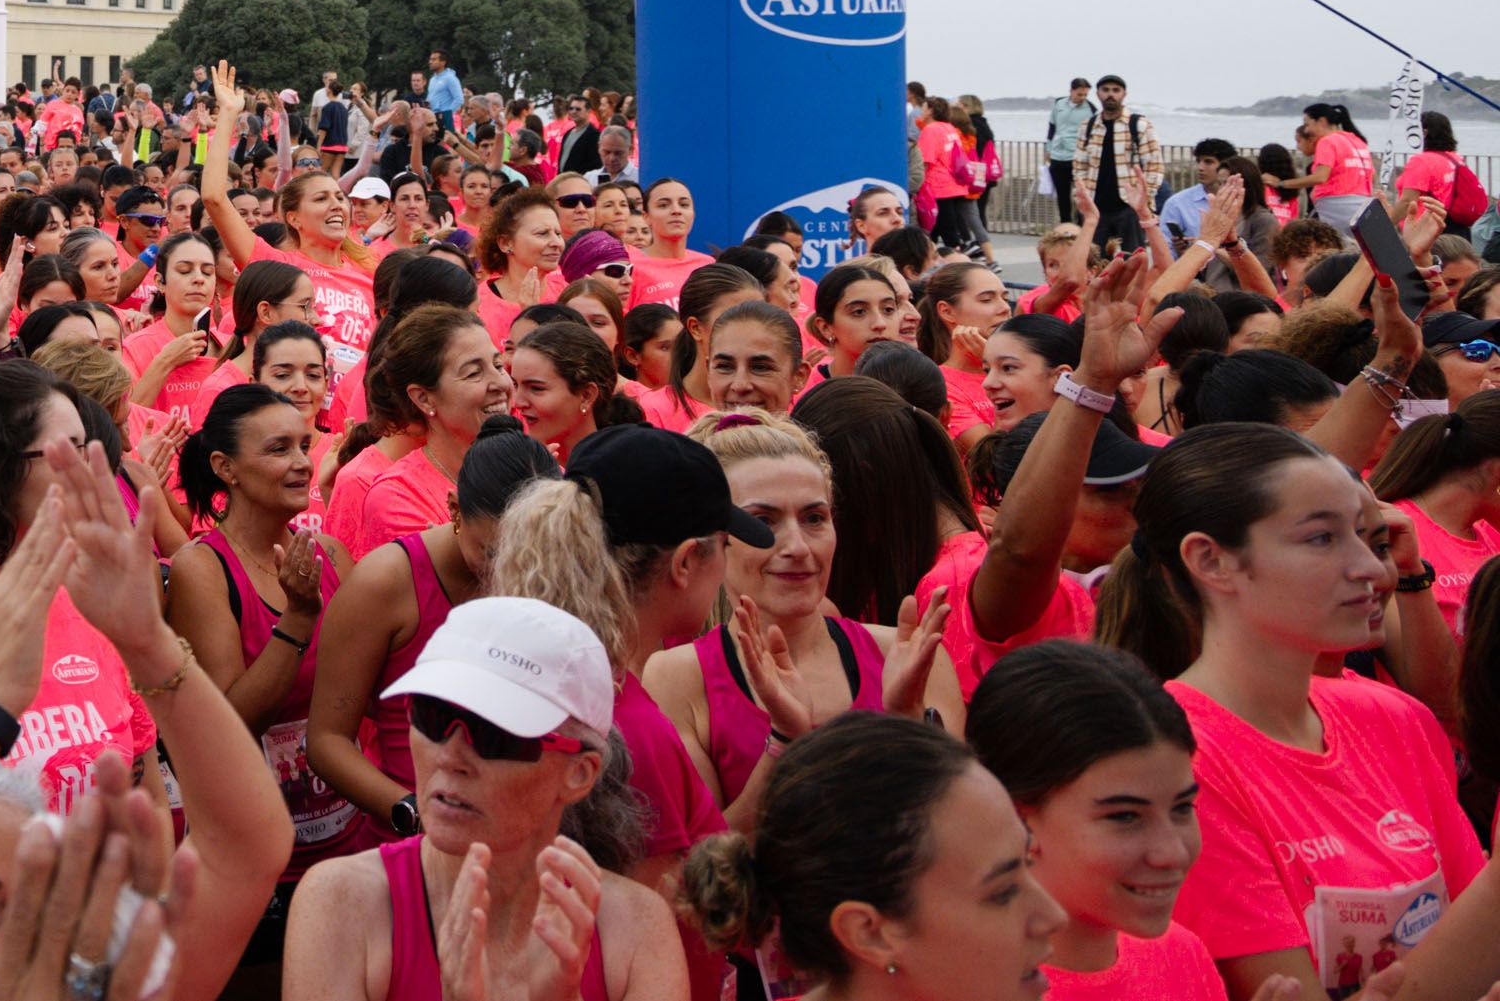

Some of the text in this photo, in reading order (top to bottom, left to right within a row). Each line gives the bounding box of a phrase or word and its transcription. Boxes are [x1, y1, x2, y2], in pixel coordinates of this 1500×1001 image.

[166, 381, 201, 392] OYSHO
[489, 648, 542, 675] OYSHO
[1340, 910, 1387, 925] SUMA
